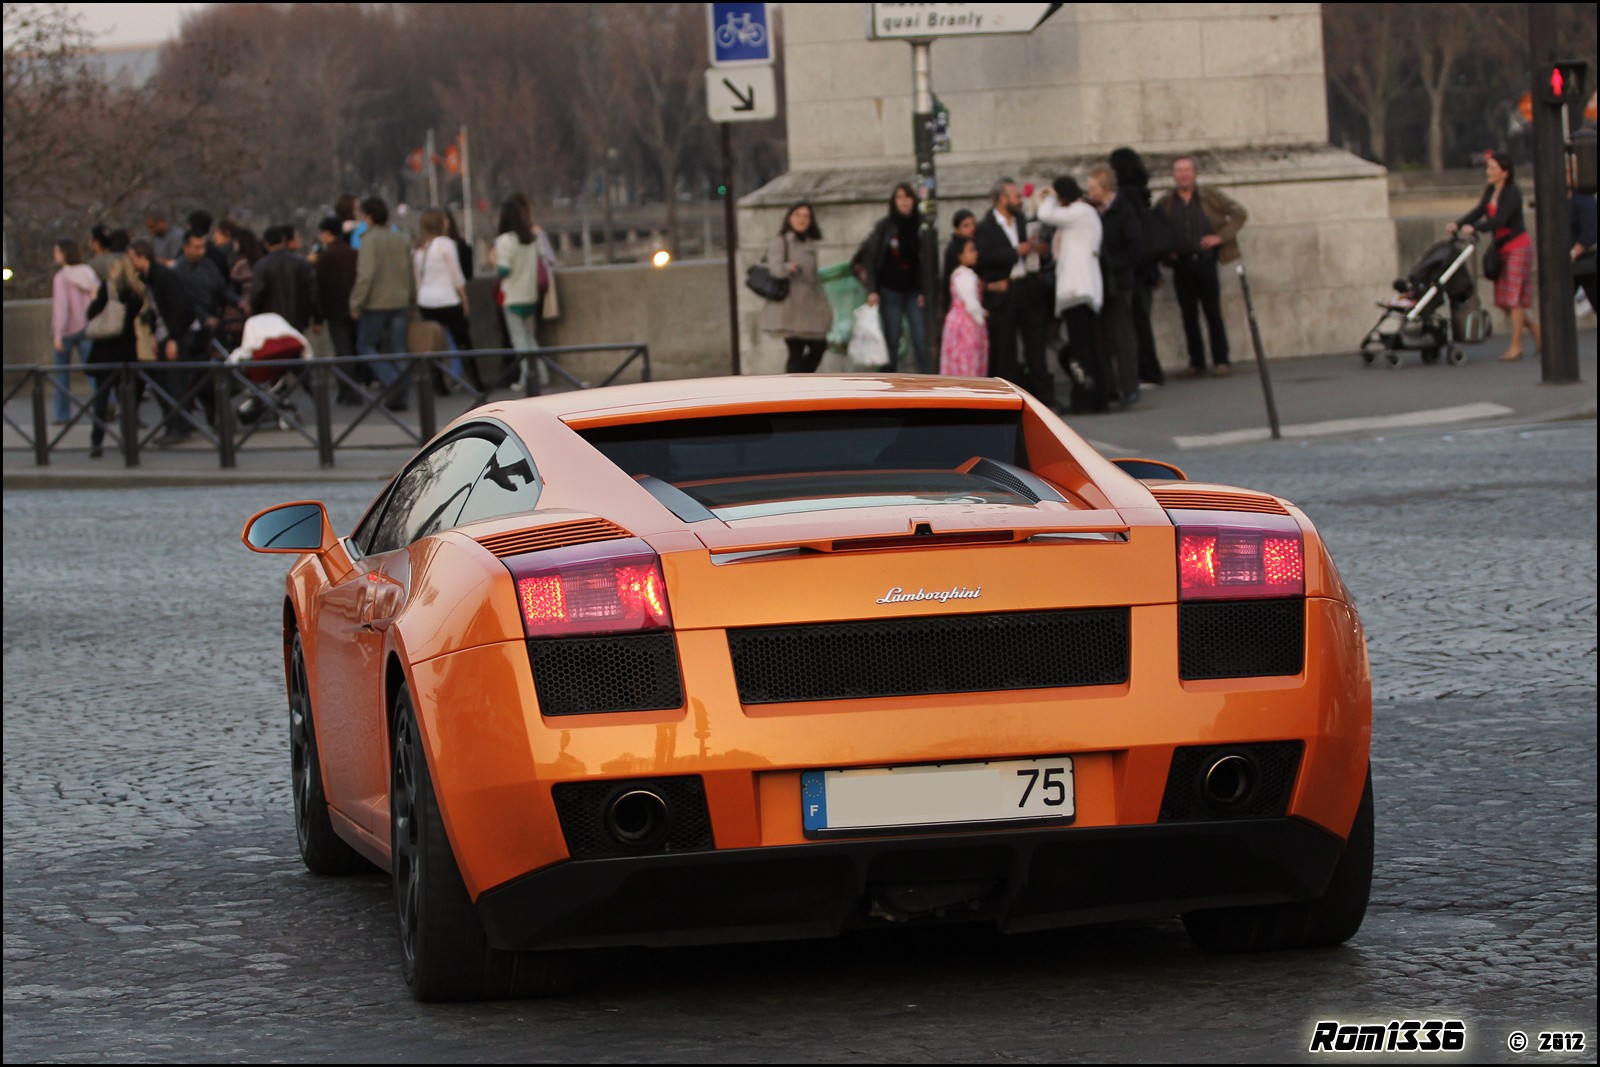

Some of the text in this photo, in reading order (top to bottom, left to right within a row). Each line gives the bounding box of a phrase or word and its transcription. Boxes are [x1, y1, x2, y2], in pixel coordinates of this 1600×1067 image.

[883, 11, 984, 31] quai Branly
[876, 586, 982, 604] Lamborghini
[1016, 768, 1065, 808] 75
[810, 804, 819, 817] F
